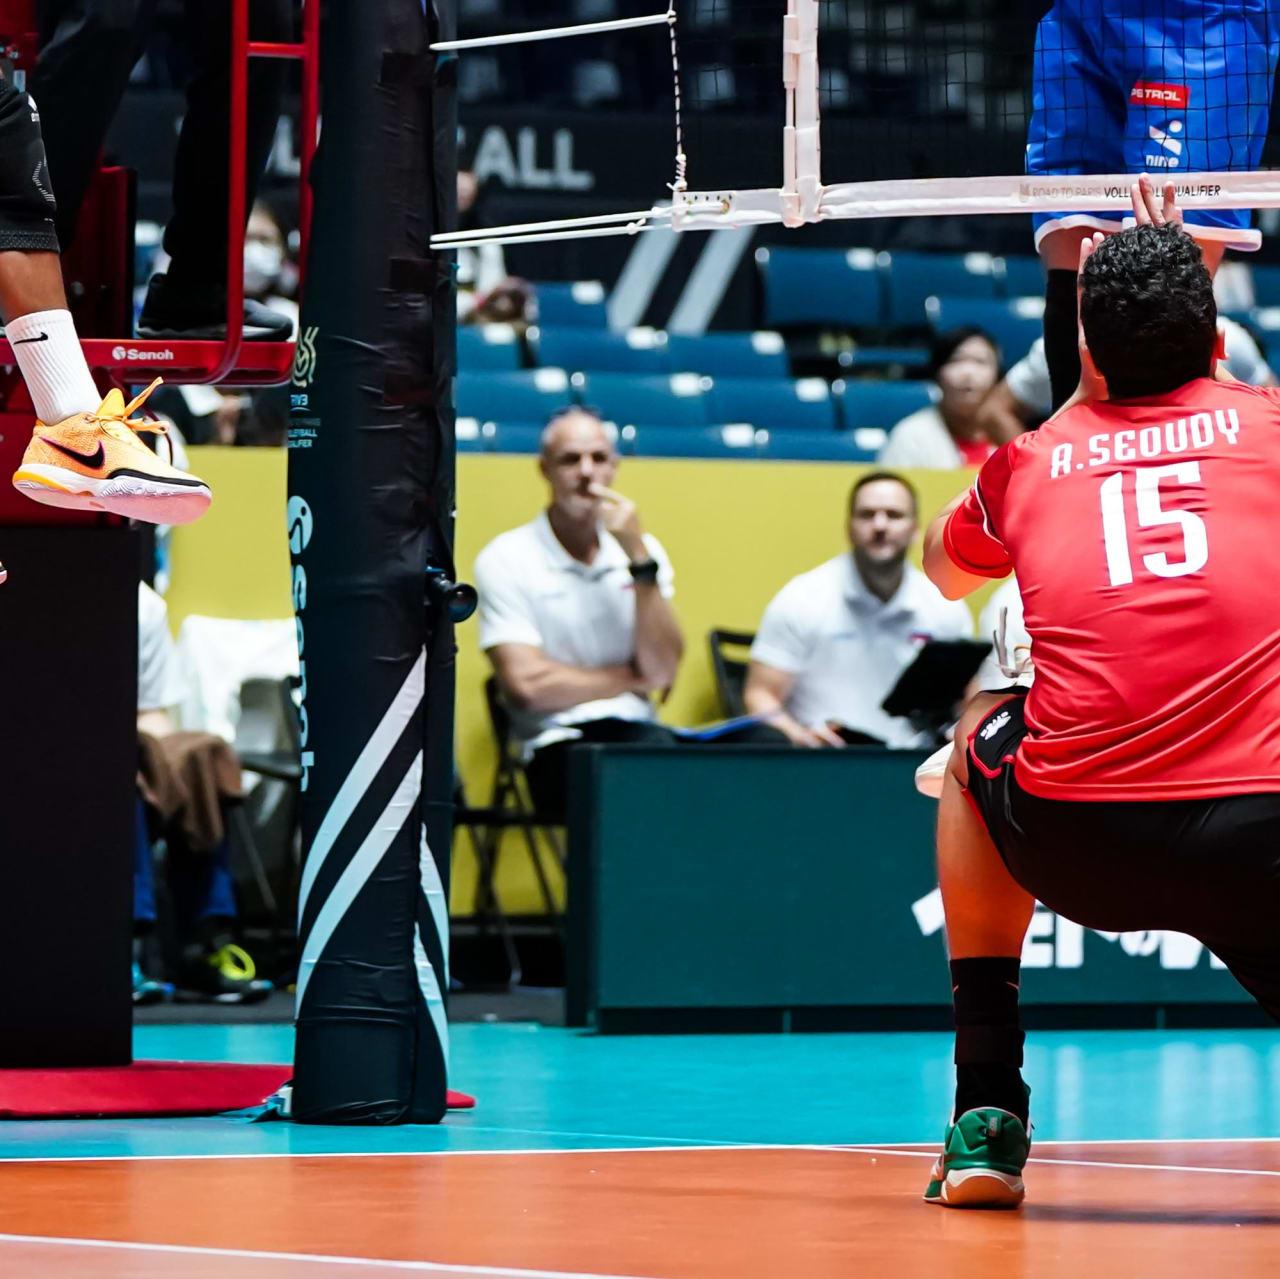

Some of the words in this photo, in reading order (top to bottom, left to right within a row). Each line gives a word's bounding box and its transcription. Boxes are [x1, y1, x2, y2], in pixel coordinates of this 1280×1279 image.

[1131, 87, 1182, 102] PETROL
[1145, 154, 1179, 168] nine
[1175, 184, 1221, 197] UALIFIER
[127, 348, 174, 360] Senoh
[1050, 408, 1241, 479] A.SEOUDY
[1100, 461, 1208, 587] 15
